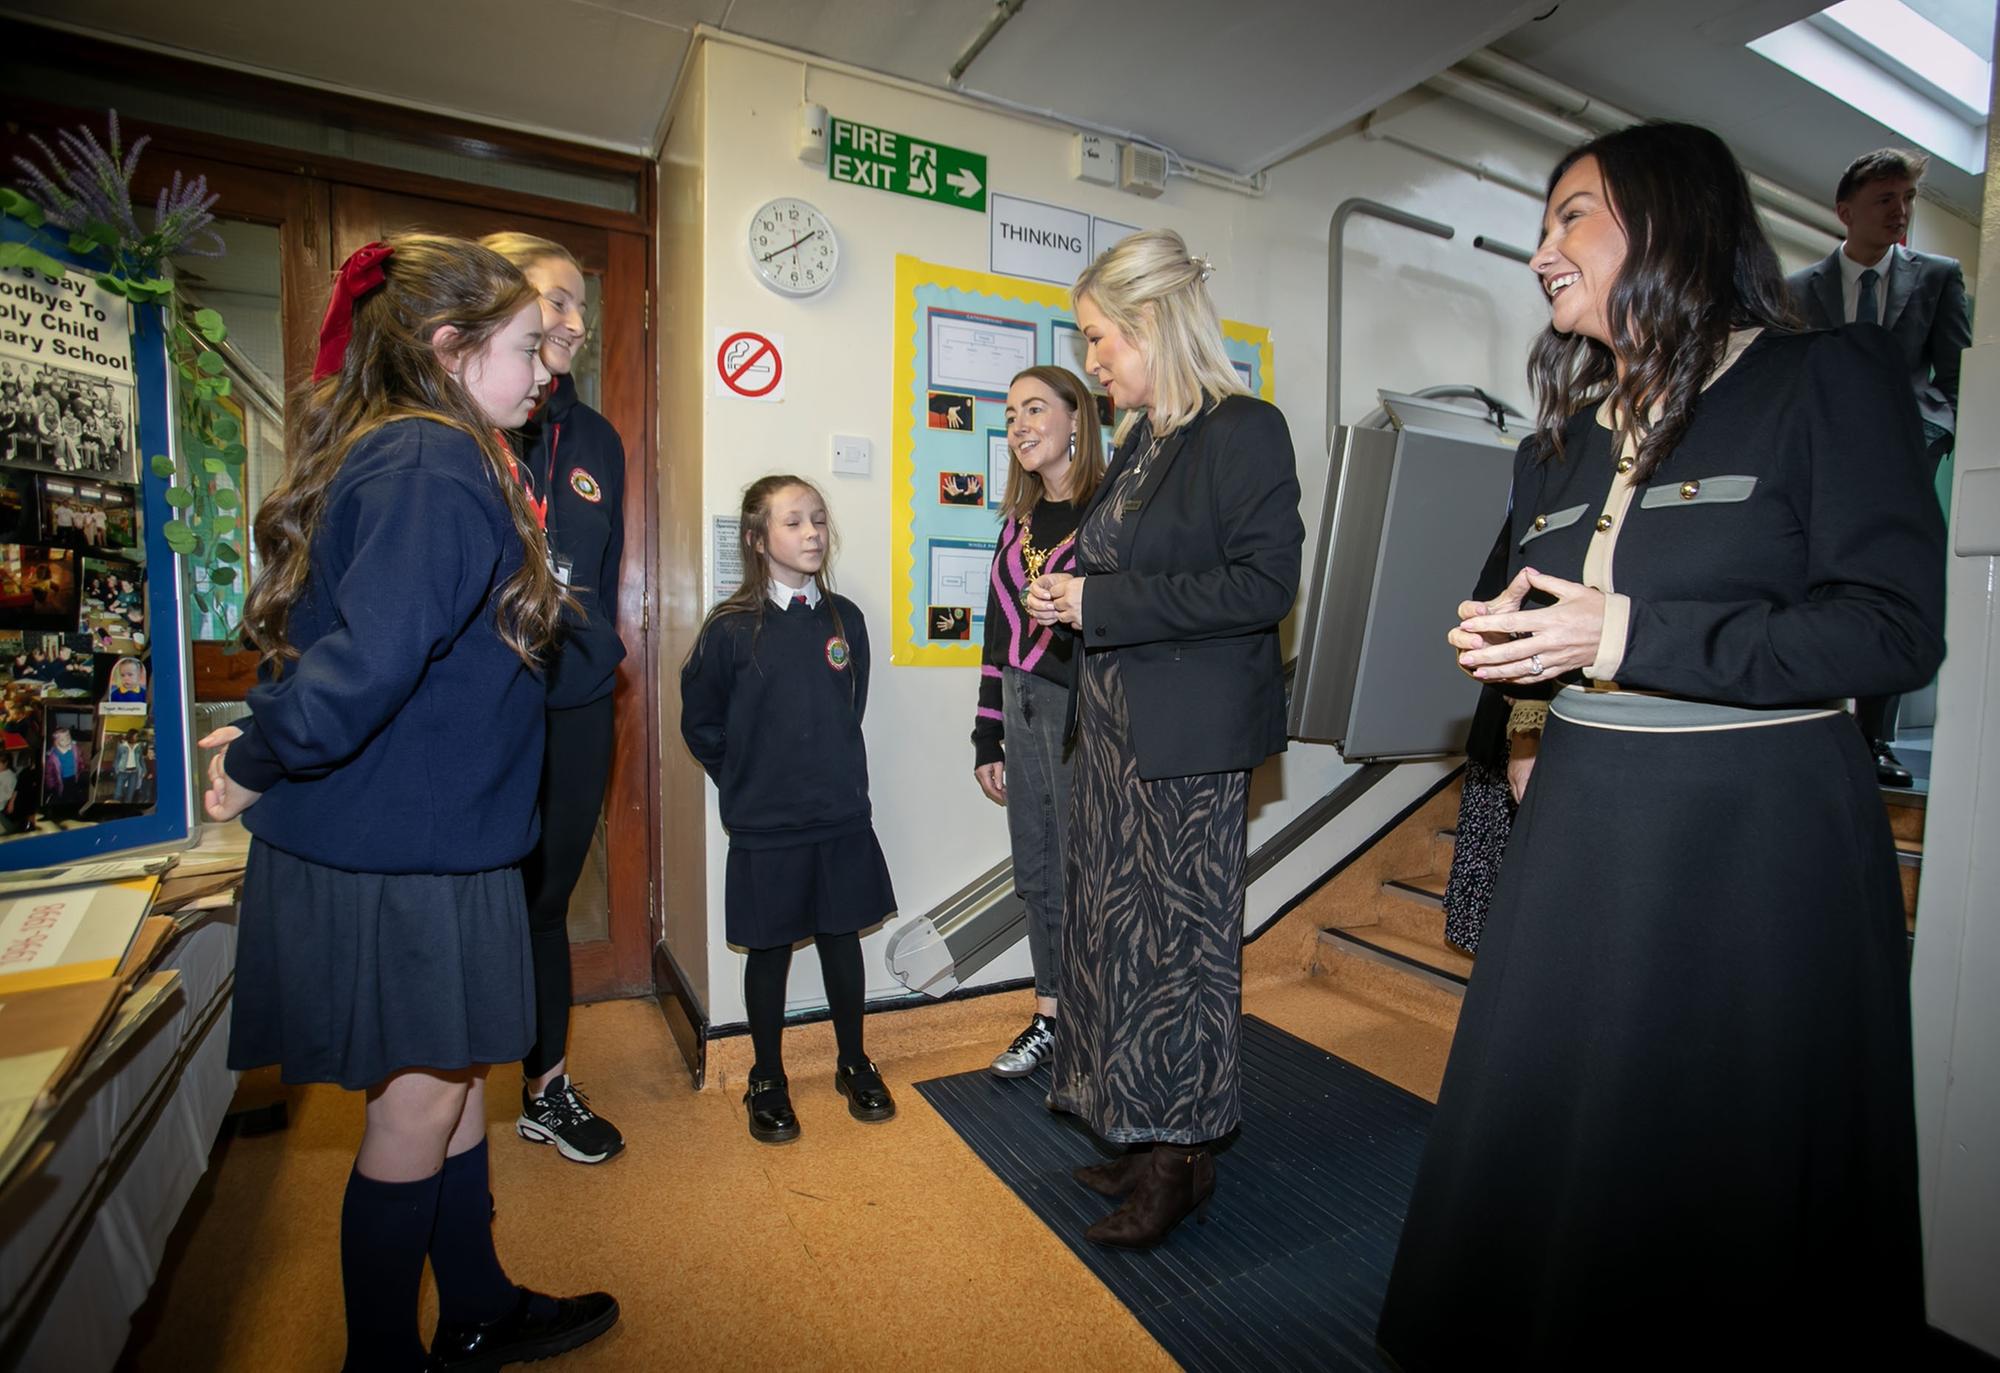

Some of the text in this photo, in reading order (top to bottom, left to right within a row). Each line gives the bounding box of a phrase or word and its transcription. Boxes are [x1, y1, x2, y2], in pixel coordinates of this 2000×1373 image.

[834, 121, 897, 159] FIRE
[834, 154, 897, 190] EXIT
[775, 212, 783, 222] 11
[789, 210, 800, 220] 12
[763, 221, 775, 232] 10
[817, 230, 824, 240] 2
[1000, 222, 1082, 254] THINKING
[760, 235, 768, 247] 9
[820, 246, 828, 256] 3
[776, 264, 783, 275] 7
[816, 261, 824, 270] 4
[790, 271, 799, 282] 6
[806, 270, 814, 280] 5
[80, 301, 106, 322] To
[41, 313, 100, 342] Child
[0, 329, 128, 371] ary School
